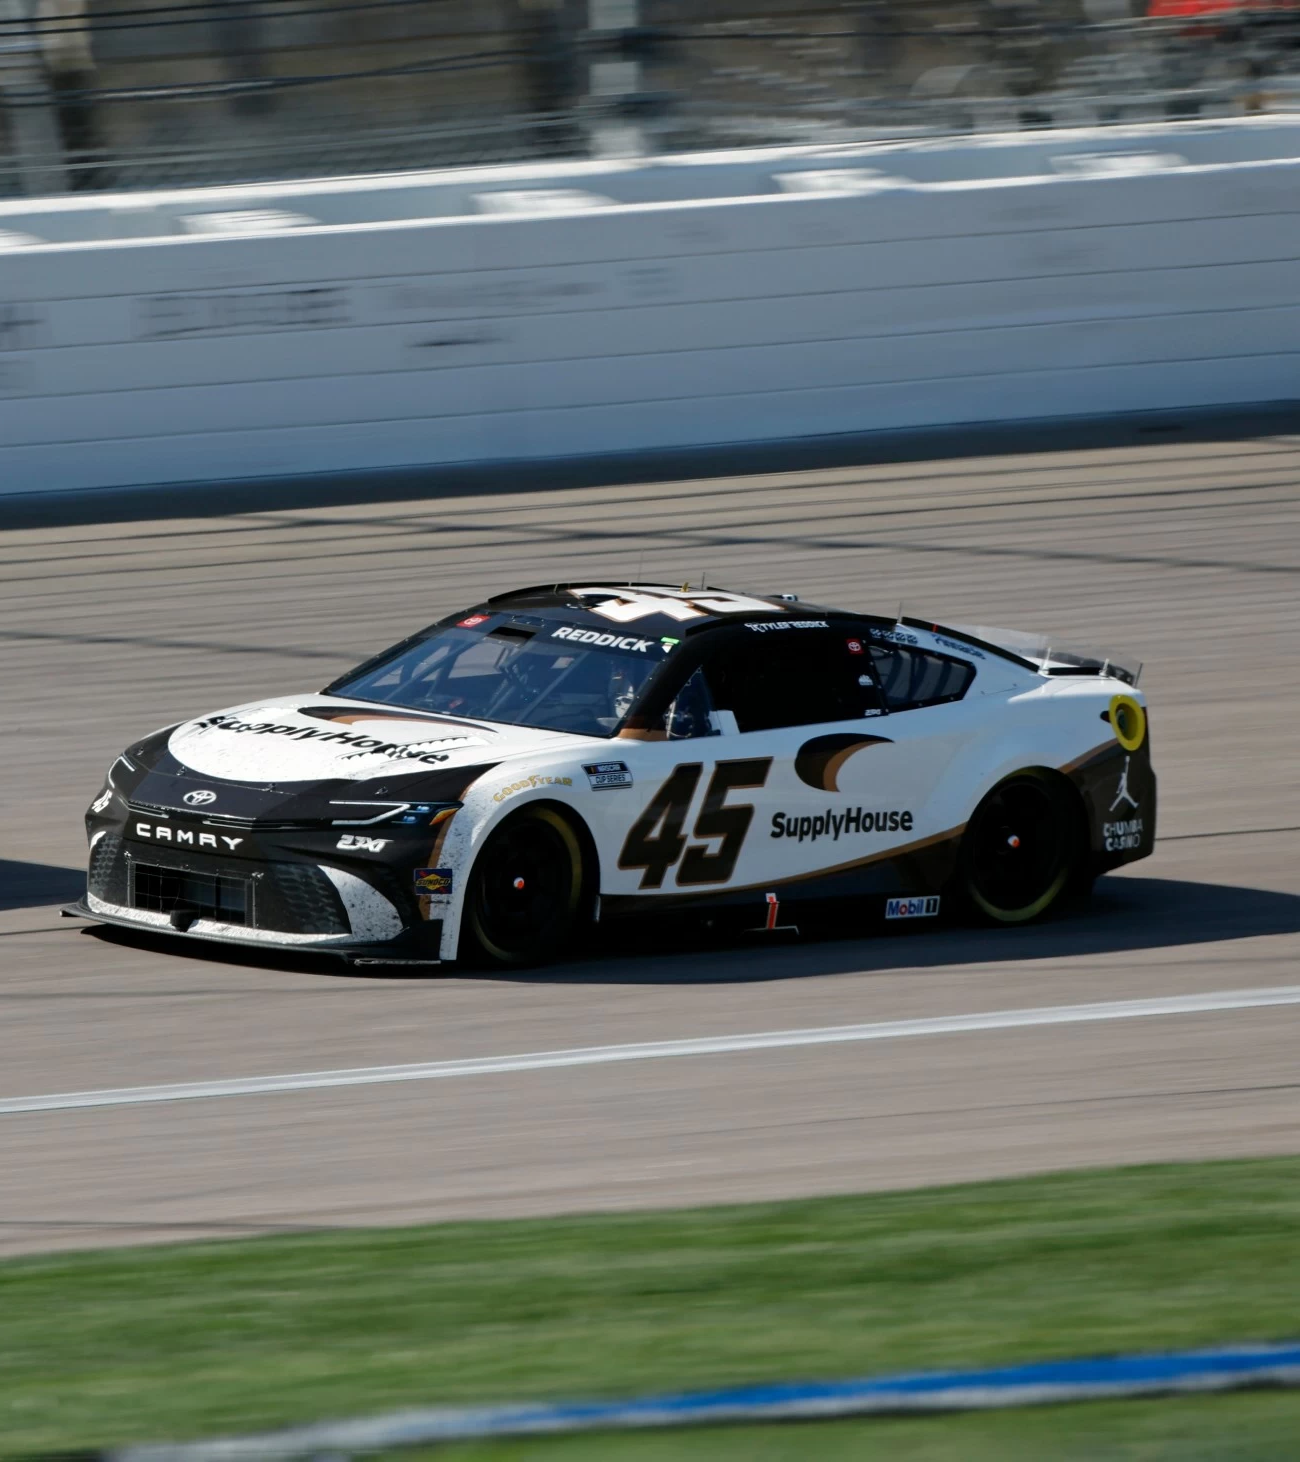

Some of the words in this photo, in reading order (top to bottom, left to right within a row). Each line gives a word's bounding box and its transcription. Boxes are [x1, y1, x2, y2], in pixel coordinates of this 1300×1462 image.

[551, 626, 655, 653] REDDICK
[493, 774, 573, 802] GOODYEAR
[136, 823, 244, 850] CAMRY
[617, 756, 773, 890] 45
[770, 807, 913, 842] SupplyHouse
[1103, 819, 1143, 837] CHUMBA
[1105, 834, 1140, 851] CASINO
[416, 878, 450, 887] SUNOCO
[888, 899, 924, 916] Mobil
